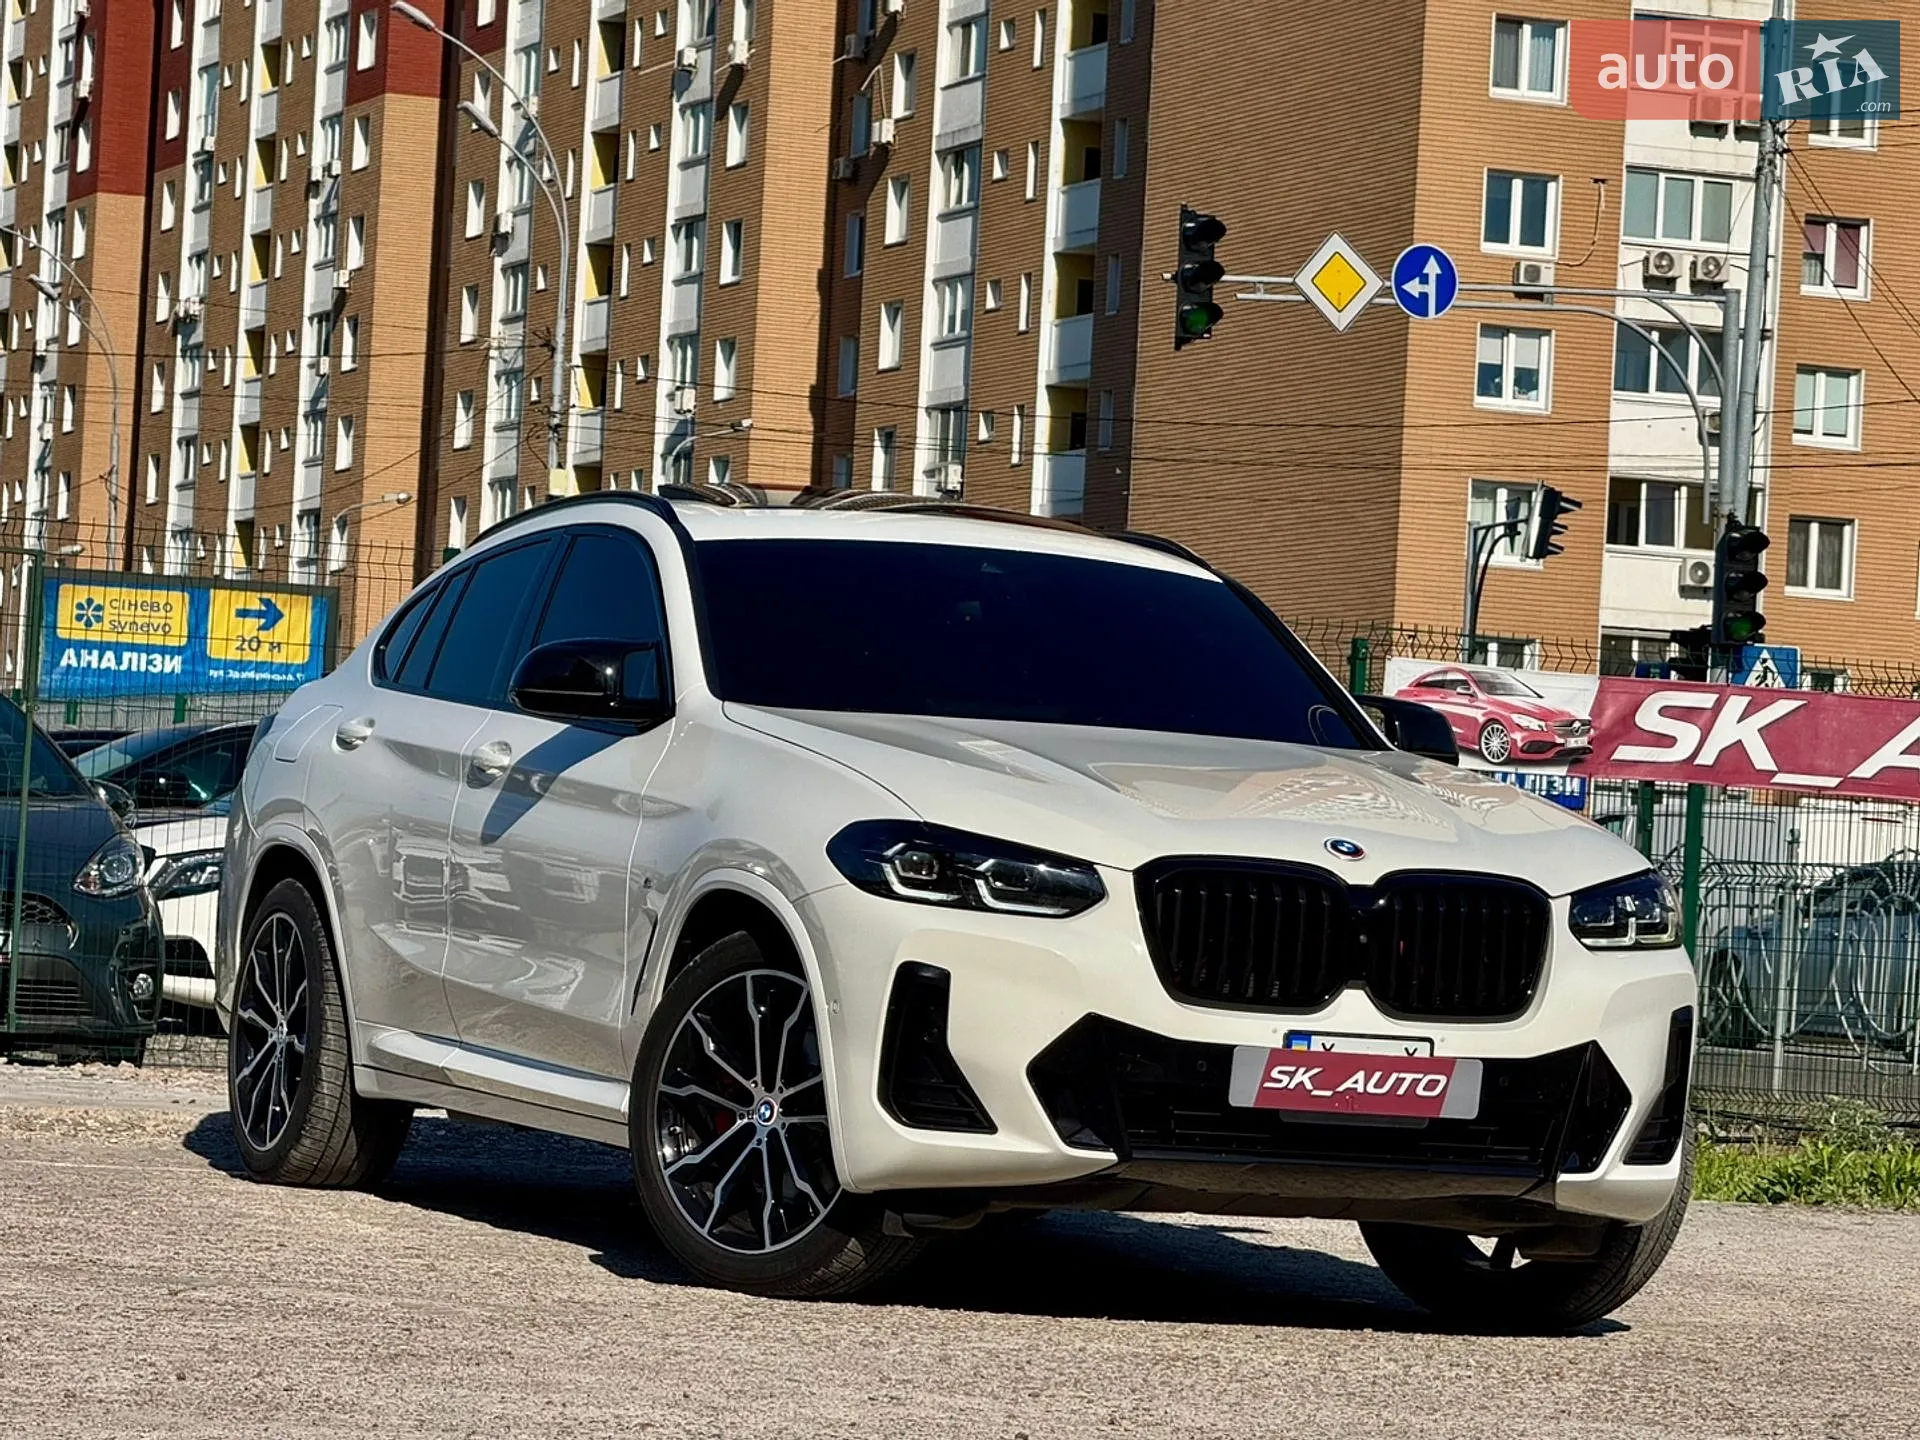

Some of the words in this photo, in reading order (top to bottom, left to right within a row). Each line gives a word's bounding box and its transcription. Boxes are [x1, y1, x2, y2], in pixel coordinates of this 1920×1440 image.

[108, 619, 172, 634] synevo
[235, 634, 261, 652] 20
[59, 647, 182, 674] АНАЛІЗИ
[1262, 1065, 1449, 1098] SK_AUTO
